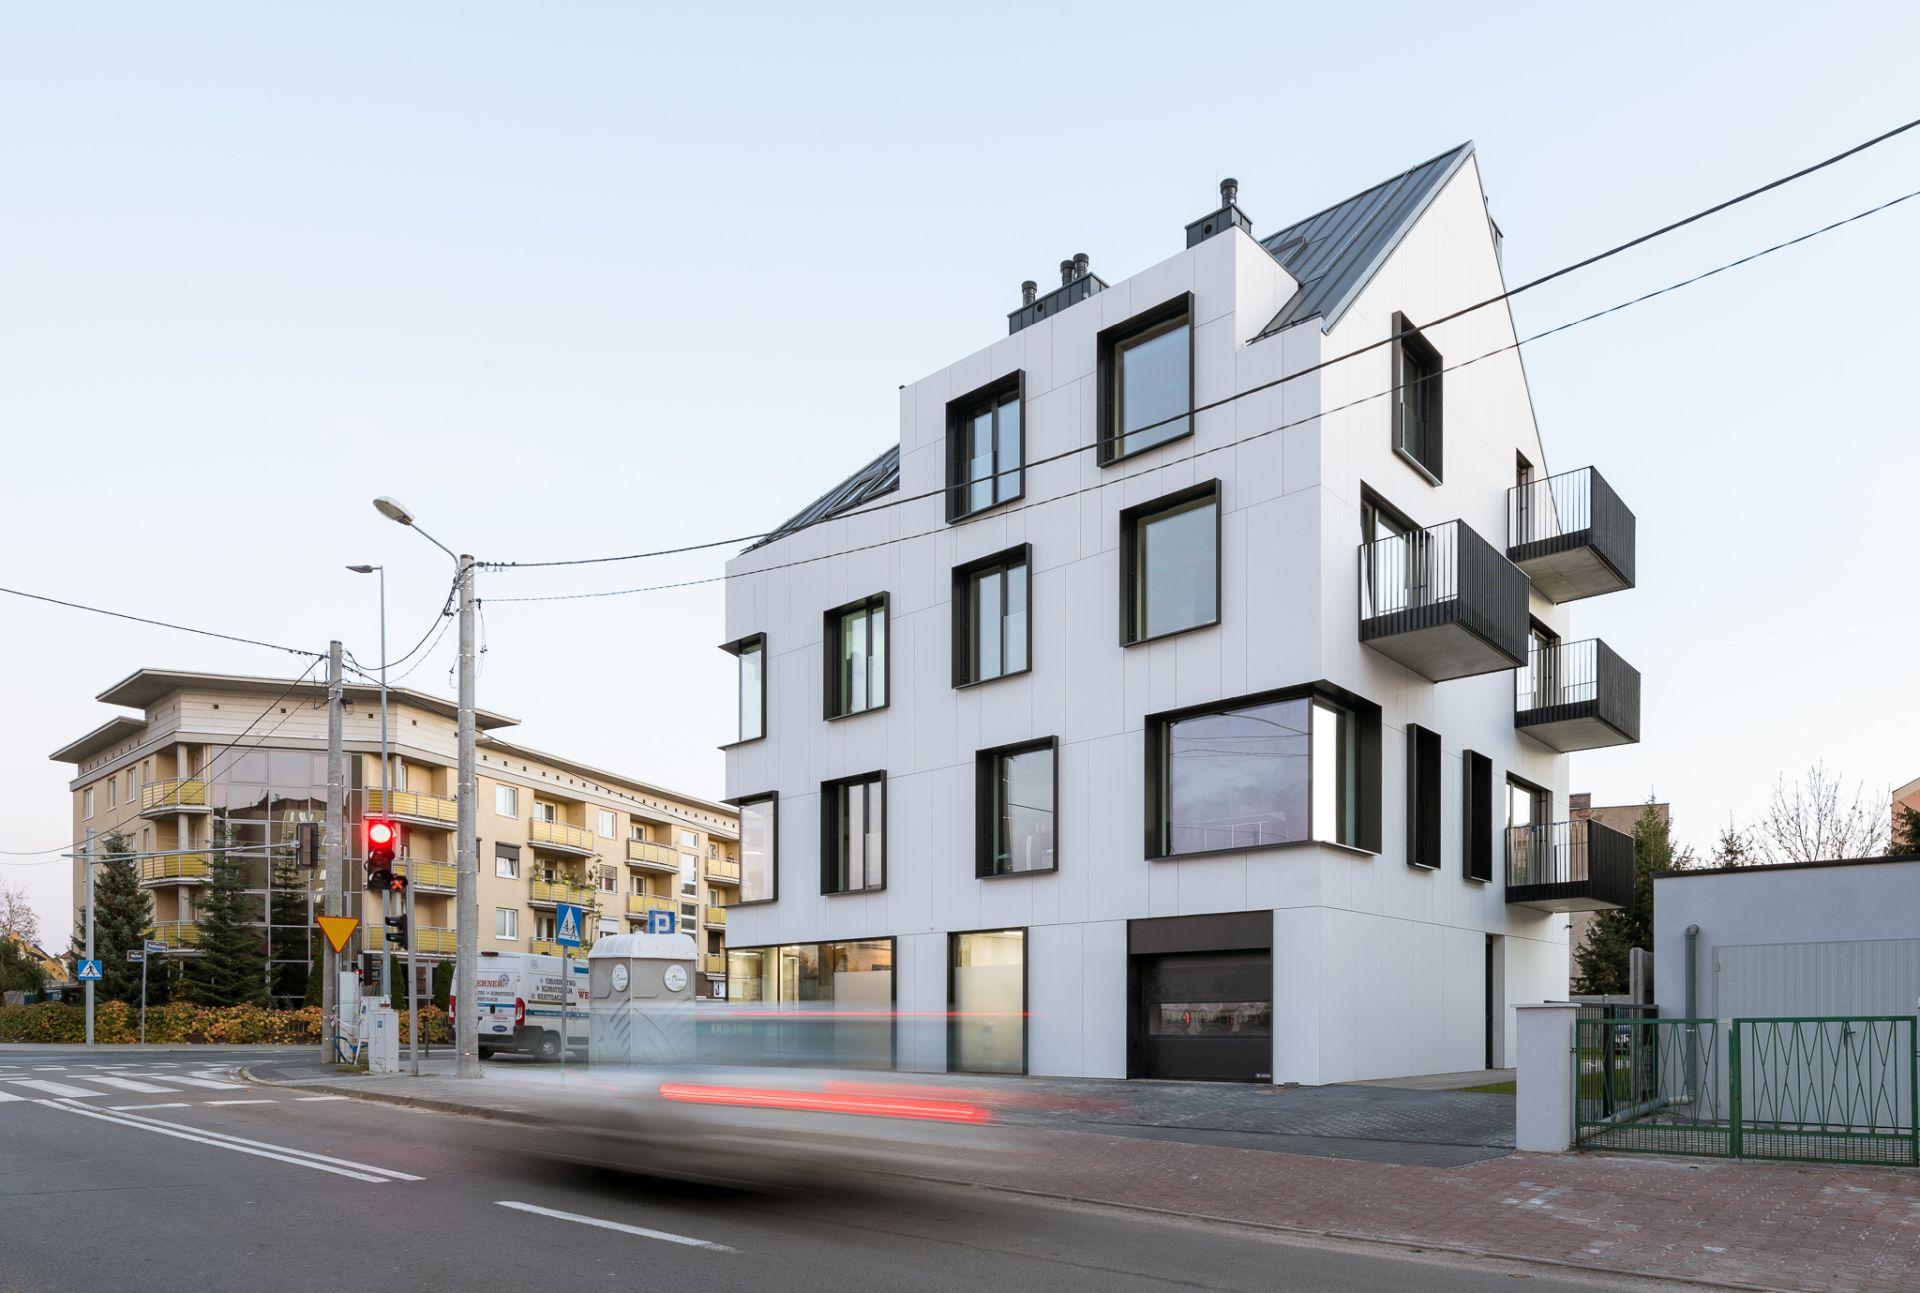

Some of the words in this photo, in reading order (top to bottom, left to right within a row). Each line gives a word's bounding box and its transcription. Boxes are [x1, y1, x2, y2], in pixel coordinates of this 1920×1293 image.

[655, 914, 670, 934] P
[476, 980, 503, 988] ERNER
[577, 991, 590, 999] WE
